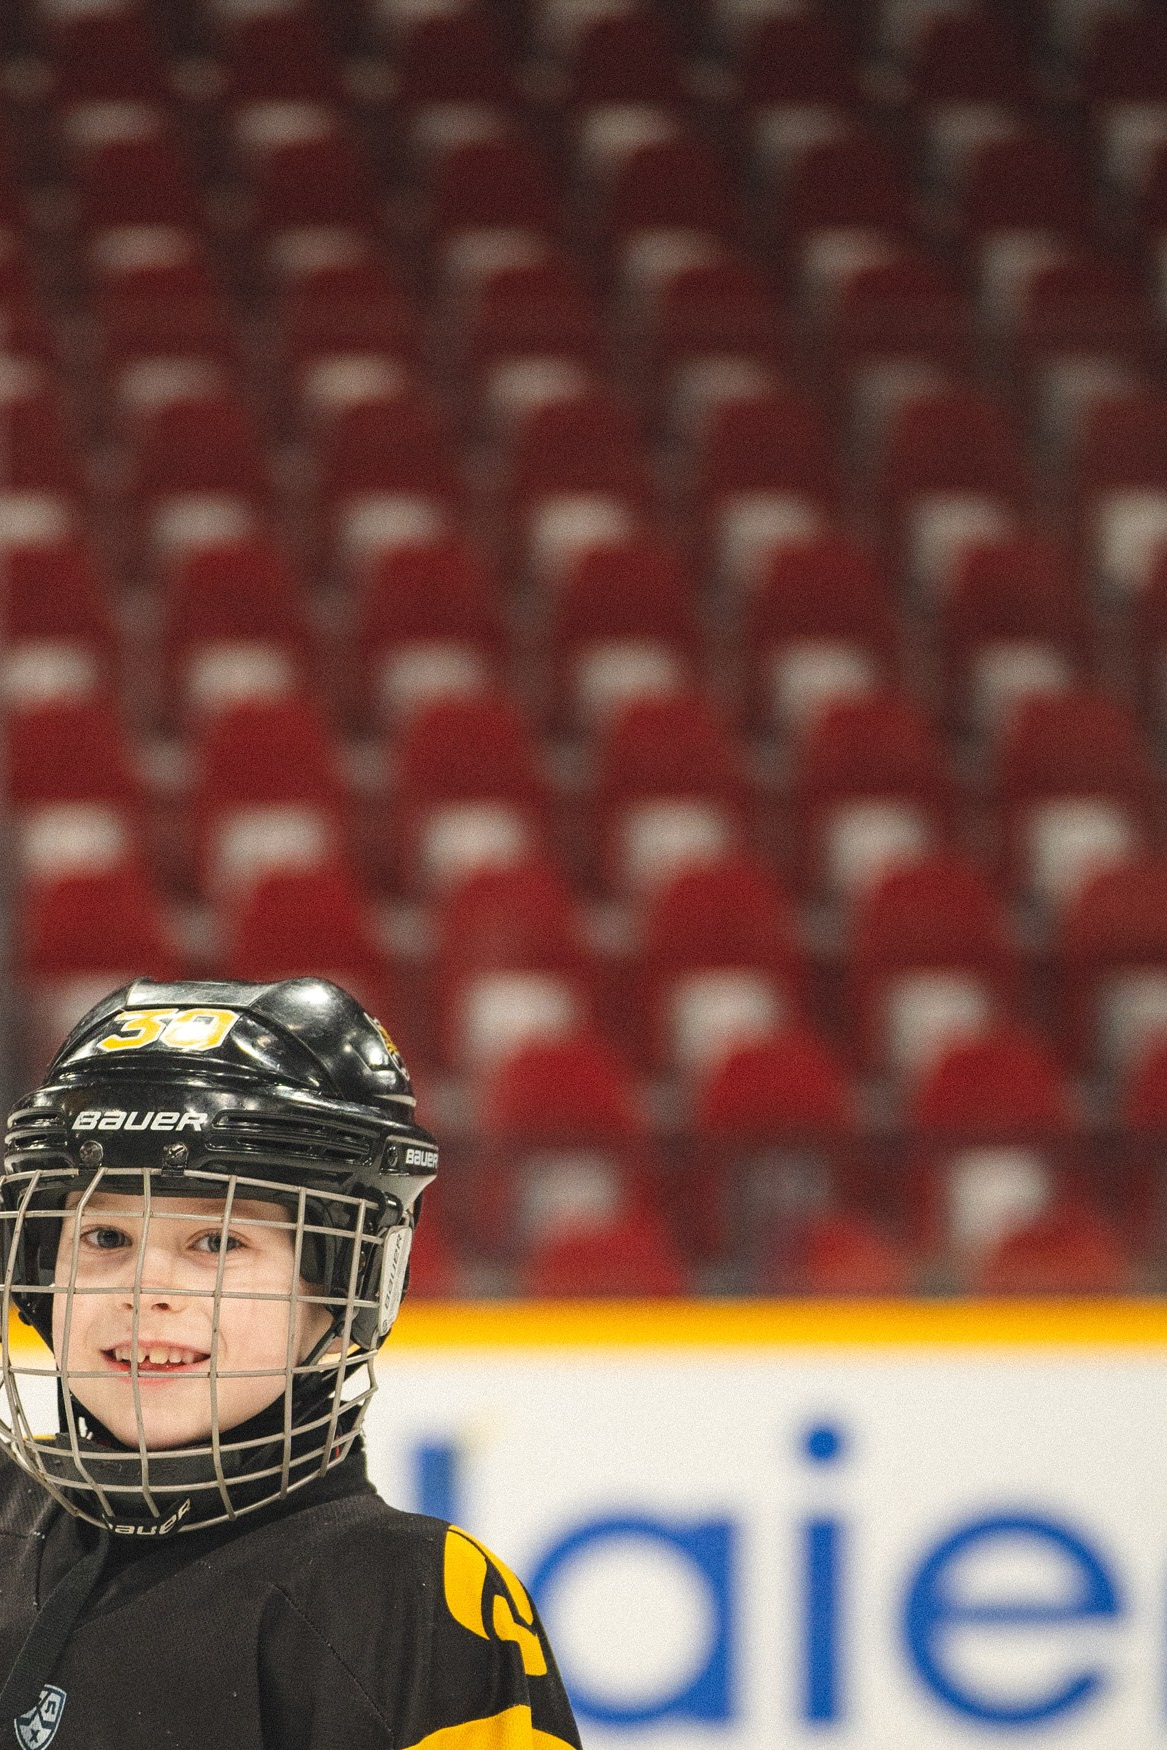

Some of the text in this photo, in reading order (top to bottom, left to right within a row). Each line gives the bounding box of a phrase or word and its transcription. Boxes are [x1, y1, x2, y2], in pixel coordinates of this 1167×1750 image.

[72, 1110, 208, 1131] BAUER
[405, 1148, 439, 1169] BAUER
[102, 1498, 191, 1535] AUER
[412, 1418, 1167, 1730] aie
